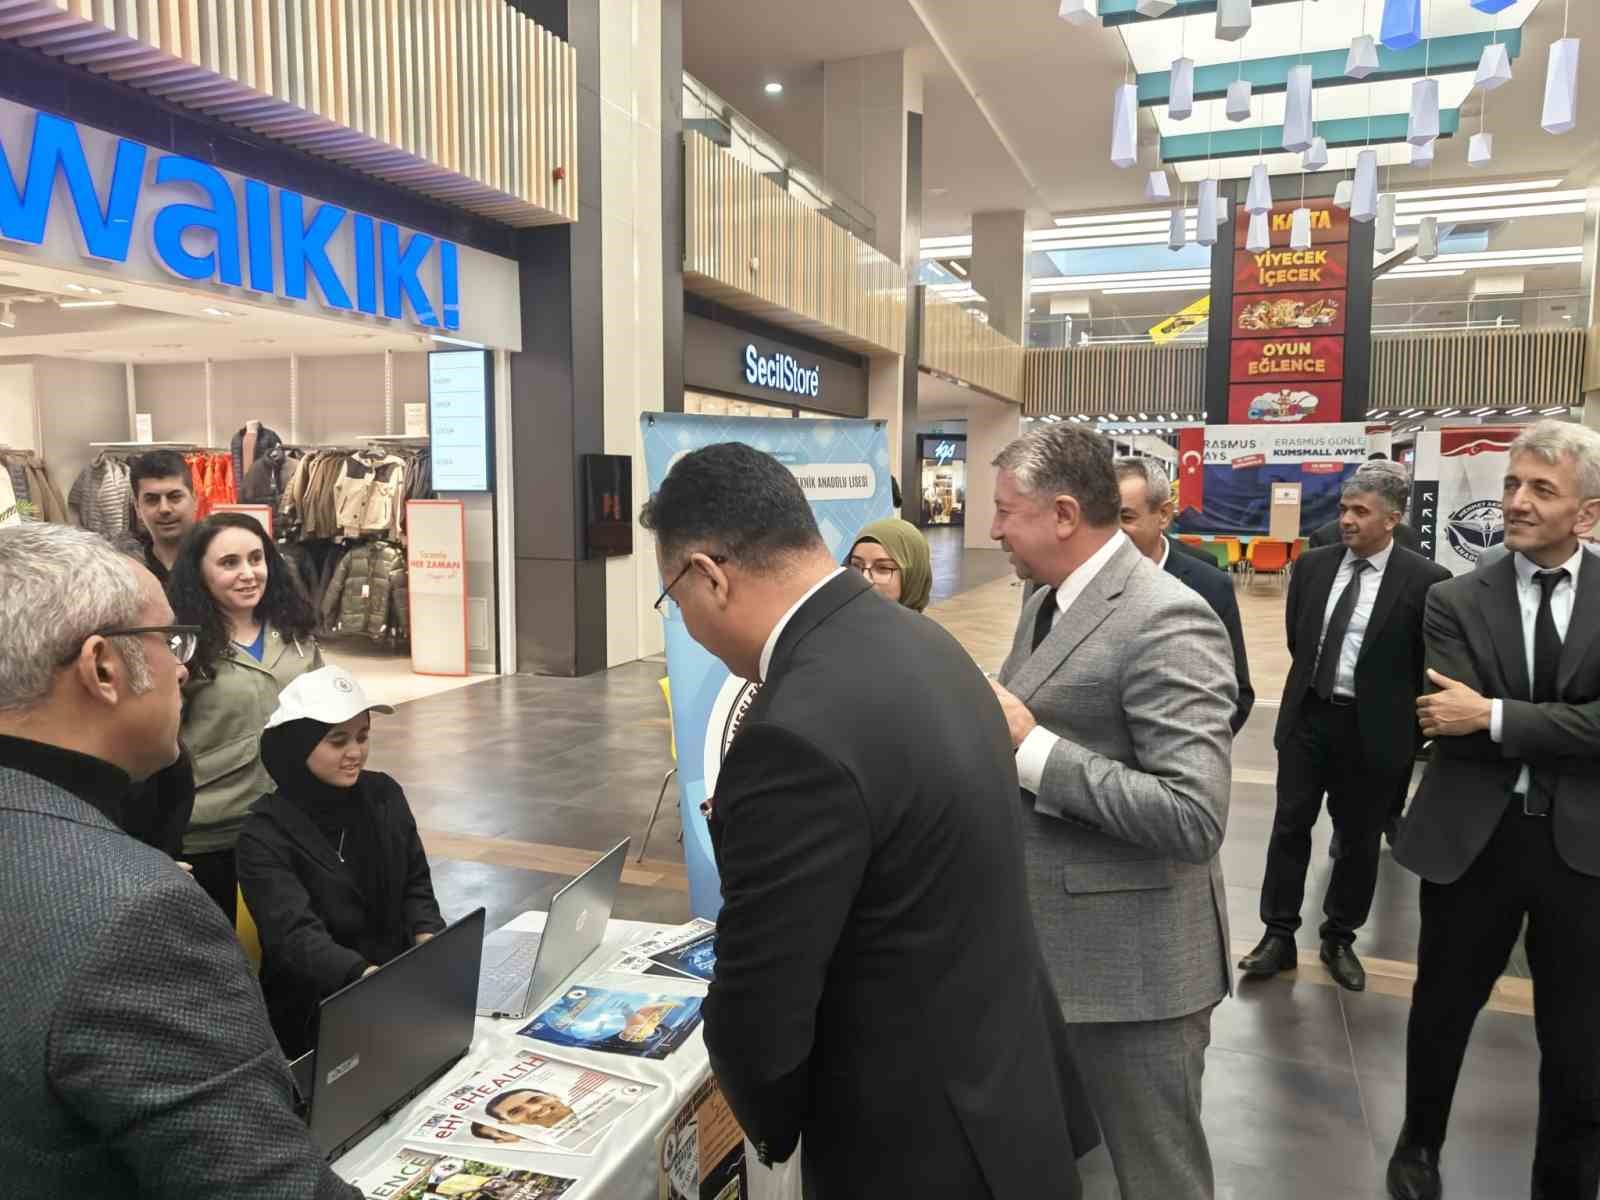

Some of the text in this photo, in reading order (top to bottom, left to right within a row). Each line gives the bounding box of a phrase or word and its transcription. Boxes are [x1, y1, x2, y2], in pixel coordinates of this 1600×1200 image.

[1271, 209, 1332, 232] KATA
[1254, 249, 1328, 267] YİYECEK
[1259, 267, 1321, 286] İÇECEK
[1263, 342, 1312, 356] OYUN
[1248, 359, 1326, 375] EĞLENCE
[1203, 439, 1257, 449] RASMUS
[1273, 437, 1325, 447] ERASMUS
[1204, 451, 1227, 460] AYS
